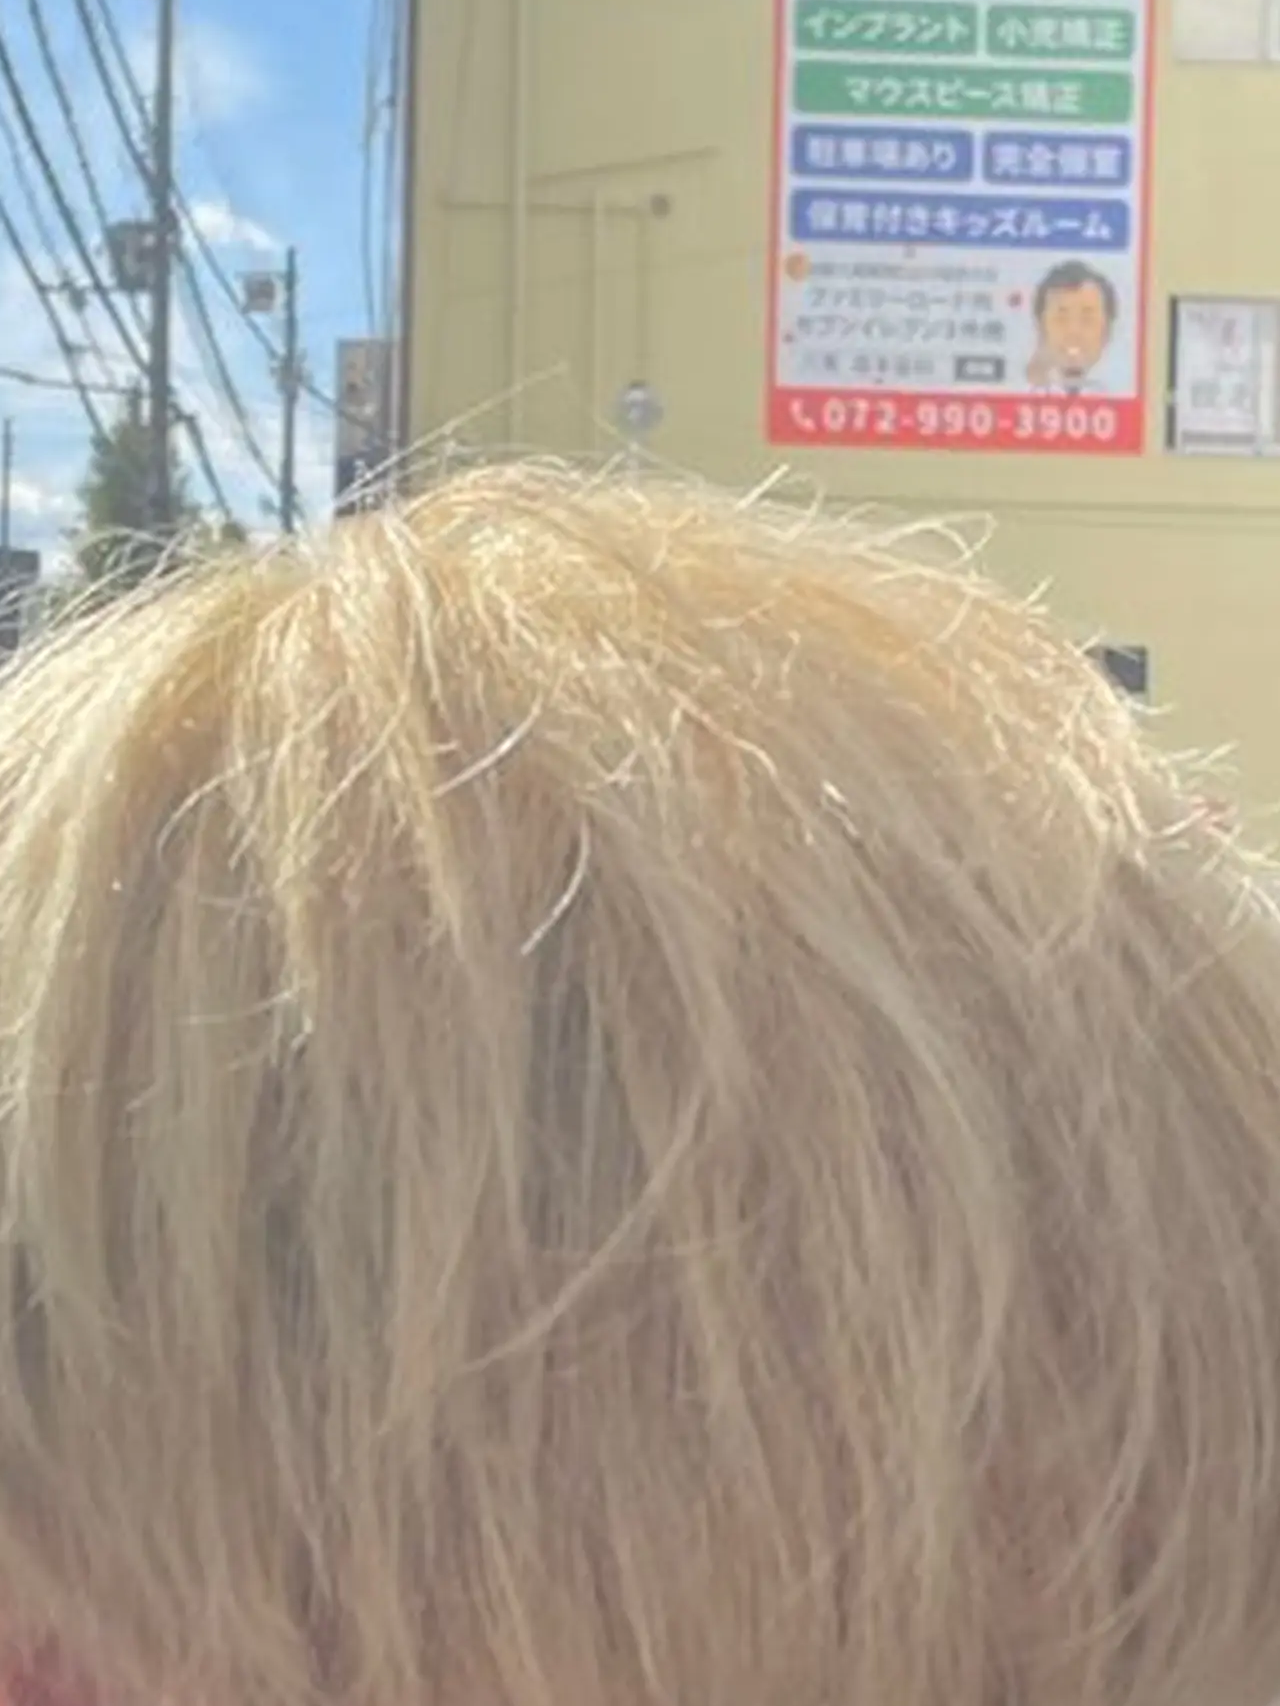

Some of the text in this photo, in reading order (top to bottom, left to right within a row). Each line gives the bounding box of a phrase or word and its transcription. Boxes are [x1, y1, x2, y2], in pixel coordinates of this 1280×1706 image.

[803, 6, 971, 43] インプラント
